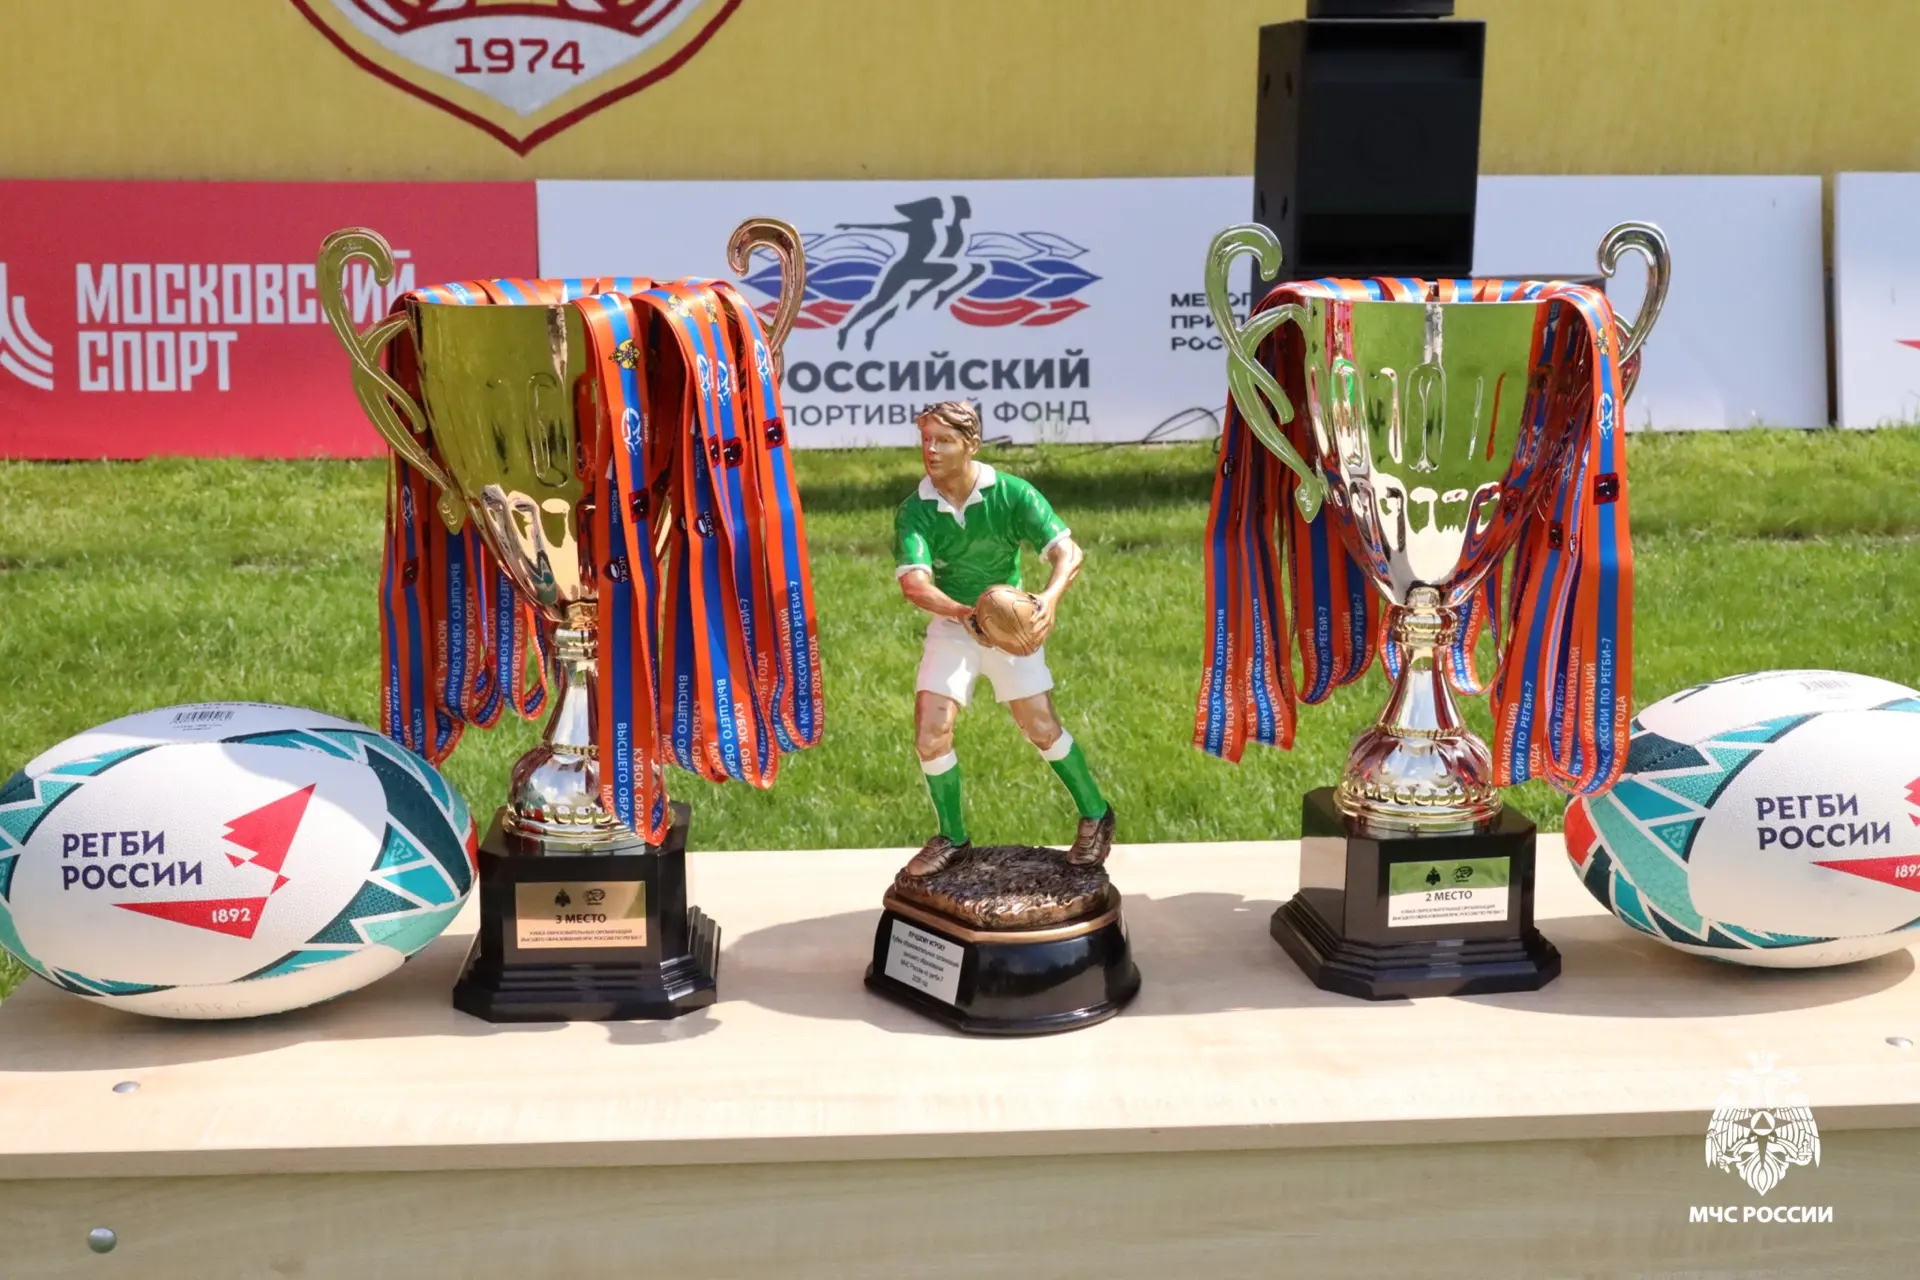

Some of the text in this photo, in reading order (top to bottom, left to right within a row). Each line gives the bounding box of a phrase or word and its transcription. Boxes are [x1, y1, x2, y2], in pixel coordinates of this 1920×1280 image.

[455, 37, 584, 75] 1974
[78, 331, 237, 391] СПОРТ
[1171, 336, 1223, 350] РОС
[787, 350, 1090, 393] ОССИЙСКИЙ
[994, 400, 1090, 425] ФОНД
[790, 580, 804, 627] РЕГБИ-7
[449, 563, 461, 707] ВЫСШЕГО ОБРАЗОВАНИЯ
[794, 631, 804, 647] ПО
[1319, 606, 1327, 647] РЕГБИ-7
[500, 611, 509, 694] ОБРАЗОВАНИЯ
[759, 651, 767, 682] ГОДА
[808, 635, 819, 666] ГОДА
[1253, 598, 1271, 737] ВЫСШЕГО ОБРАЗОВАНИЯ
[1599, 637, 1611, 684] РЕГБИ-7
[795, 651, 808, 695] РОССИИ
[811, 670, 821, 695] 2026
[1198, 667, 1212, 716] МОСКВА,
[1208, 609, 1225, 747] ВЫСШЕГО ОБРАЗОВАНИЯ
[1245, 657, 1253, 709] МОСКВА,
[1564, 647, 1581, 728] ОРГАНИЗАЦИЙ
[677, 675, 688, 734] ВЫСШЕГО
[716, 679, 732, 739] ВЫСШЕГО
[798, 699, 810, 724] МЧС
[812, 698, 822, 724] МАЯ
[1520, 681, 1533, 728] РЕГБИ-7
[1584, 663, 1596, 744] ОРГАНИЗАЦИЙ
[1599, 688, 1610, 704] ПО
[1615, 696, 1626, 727] ГОДА
[734, 702, 747, 744] КУБОК
[1517, 732, 1527, 749] ПО
[1554, 722, 1562, 737] ПО
[1599, 708, 1610, 752] РОССИИ
[617, 723, 628, 783] ВЫСШЕГО
[1501, 702, 1519, 785] ОРГАНИЗАЦИЙ
[1530, 743, 1540, 772] ГОДА
[1614, 732, 1624, 756] 2026
[633, 748, 643, 789] КУБОК
[1755, 793, 1858, 821] РЕГБИ
[62, 830, 165, 859] РЕГБИ
[1757, 821, 1891, 850] РОССИИ
[62, 861, 203, 890] РОССИИ
[211, 907, 251, 924] 1892
[1425, 890, 1473, 902] 2 МЕСТО
[555, 913, 607, 924] 3 МЕСТО
